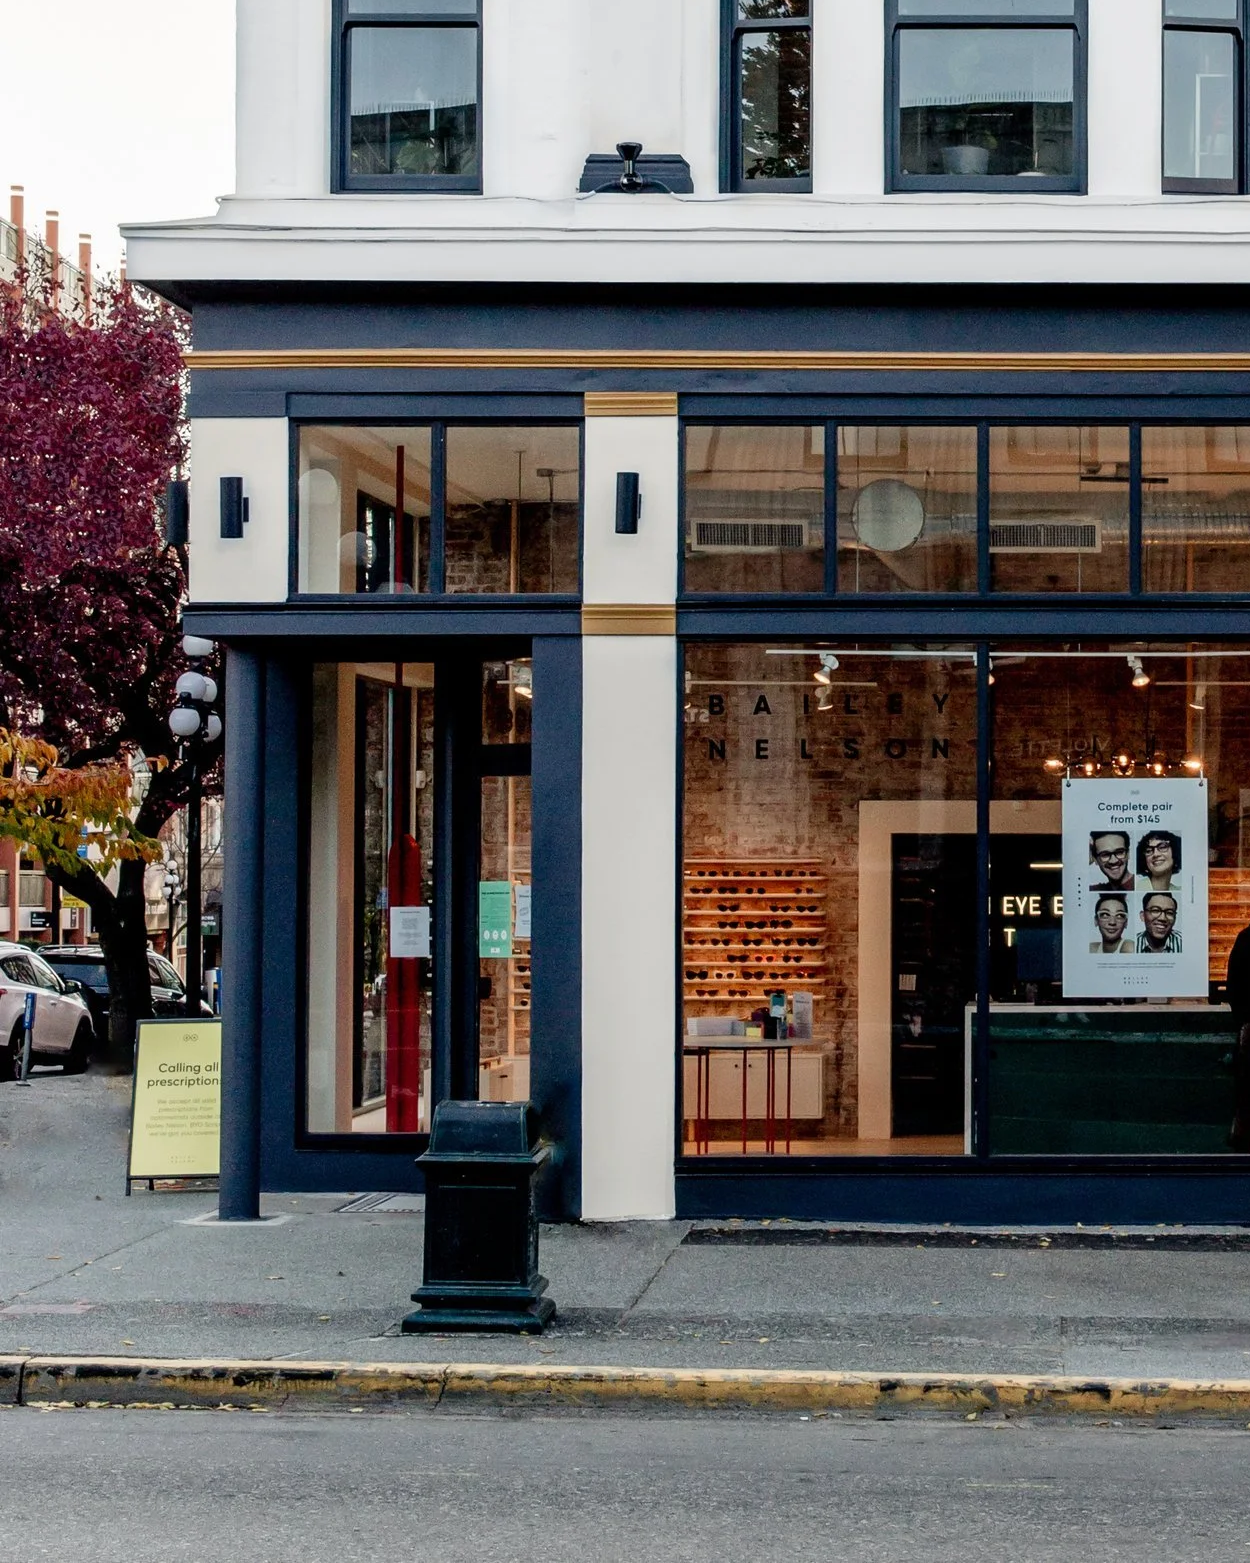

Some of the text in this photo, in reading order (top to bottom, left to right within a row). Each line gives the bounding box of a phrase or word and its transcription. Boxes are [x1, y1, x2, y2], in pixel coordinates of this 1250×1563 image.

[708, 693, 949, 716] BAILEY
[708, 738, 949, 760] NELSON
[1097, 801, 1173, 813] Complete pair
[1110, 814, 1161, 824] from $145
[1002, 895, 1042, 916] EYE
[158, 1062, 219, 1074] Calling all
[147, 1076, 221, 1089] prescription
